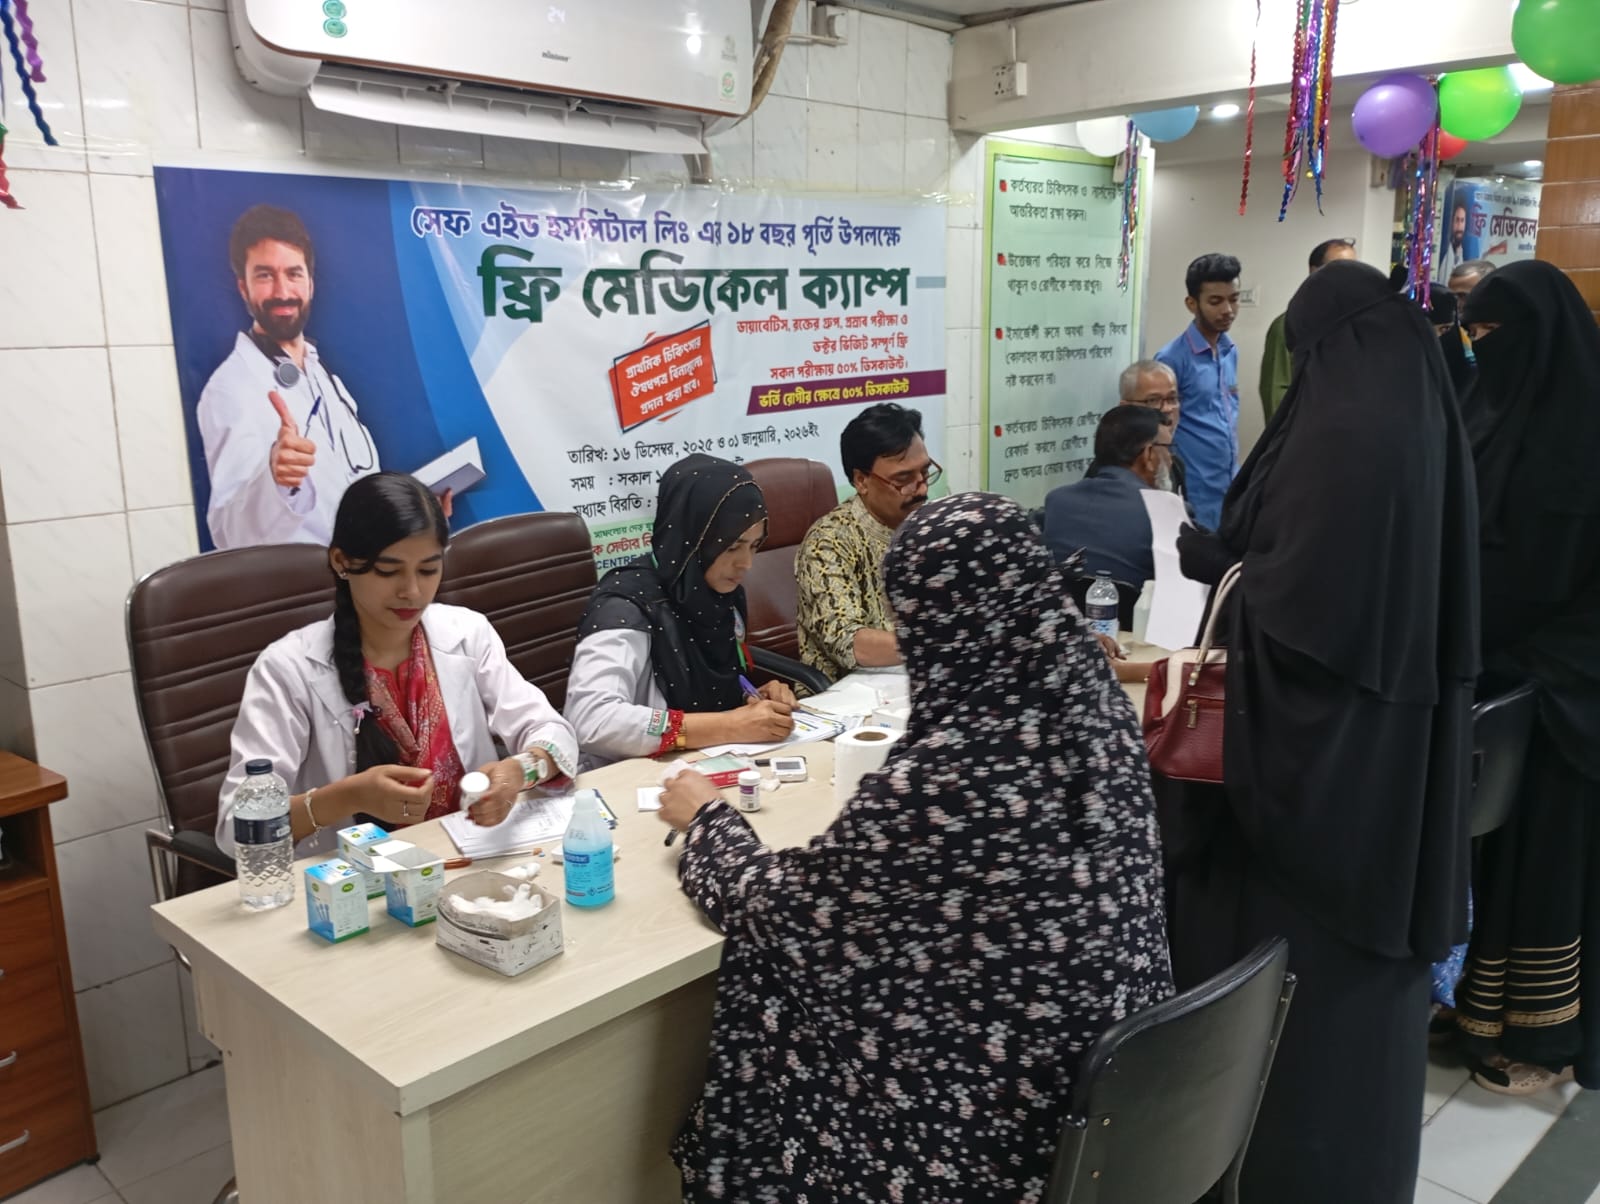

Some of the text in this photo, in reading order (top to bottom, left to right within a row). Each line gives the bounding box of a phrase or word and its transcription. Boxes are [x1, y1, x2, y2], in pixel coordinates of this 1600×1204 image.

[412, 207, 471, 236] সেফ
[481, 202, 540, 239] এইড
[547, 208, 647, 243] হসপিটাল
[698, 221, 721, 246] এর
[728, 222, 755, 244] ১৮
[760, 223, 796, 247] বছর
[802, 216, 834, 256] পূর্তি
[838, 217, 902, 246] উপলক্ষে
[1490, 207, 1537, 239] মেডিকেল
[477, 244, 910, 323] ফ্রি মেডিকেল ক্যাম্প
[870, 310, 898, 327] পরীক্ষা
[900, 315, 908, 326] ও
[840, 335, 868, 351] ভিজিট
[871, 332, 895, 353] সম্পূর্ণ
[897, 332, 908, 349] ফ্রি
[770, 367, 795, 380] সকল
[797, 360, 834, 378] পরীক্ষায়
[837, 362, 858, 374] ৫০%
[640, 395, 664, 414] প্রদান
[665, 386, 682, 402] করা
[759, 389, 781, 407] ভর্তি
[783, 386, 812, 405] রোগীর
[814, 389, 840, 403] ক্ষেত্রে
[842, 387, 864, 399] ৫০%
[613, 447, 630, 461] ১৬
[682, 438, 714, 453] ২০২৫
[718, 437, 725, 449] ও
[728, 435, 739, 447] ০১
[570, 476, 595, 491] সময়
[618, 471, 652, 486] সকাল
[609, 493, 644, 513] বিরতি
[606, 537, 640, 554] সেন্টার
